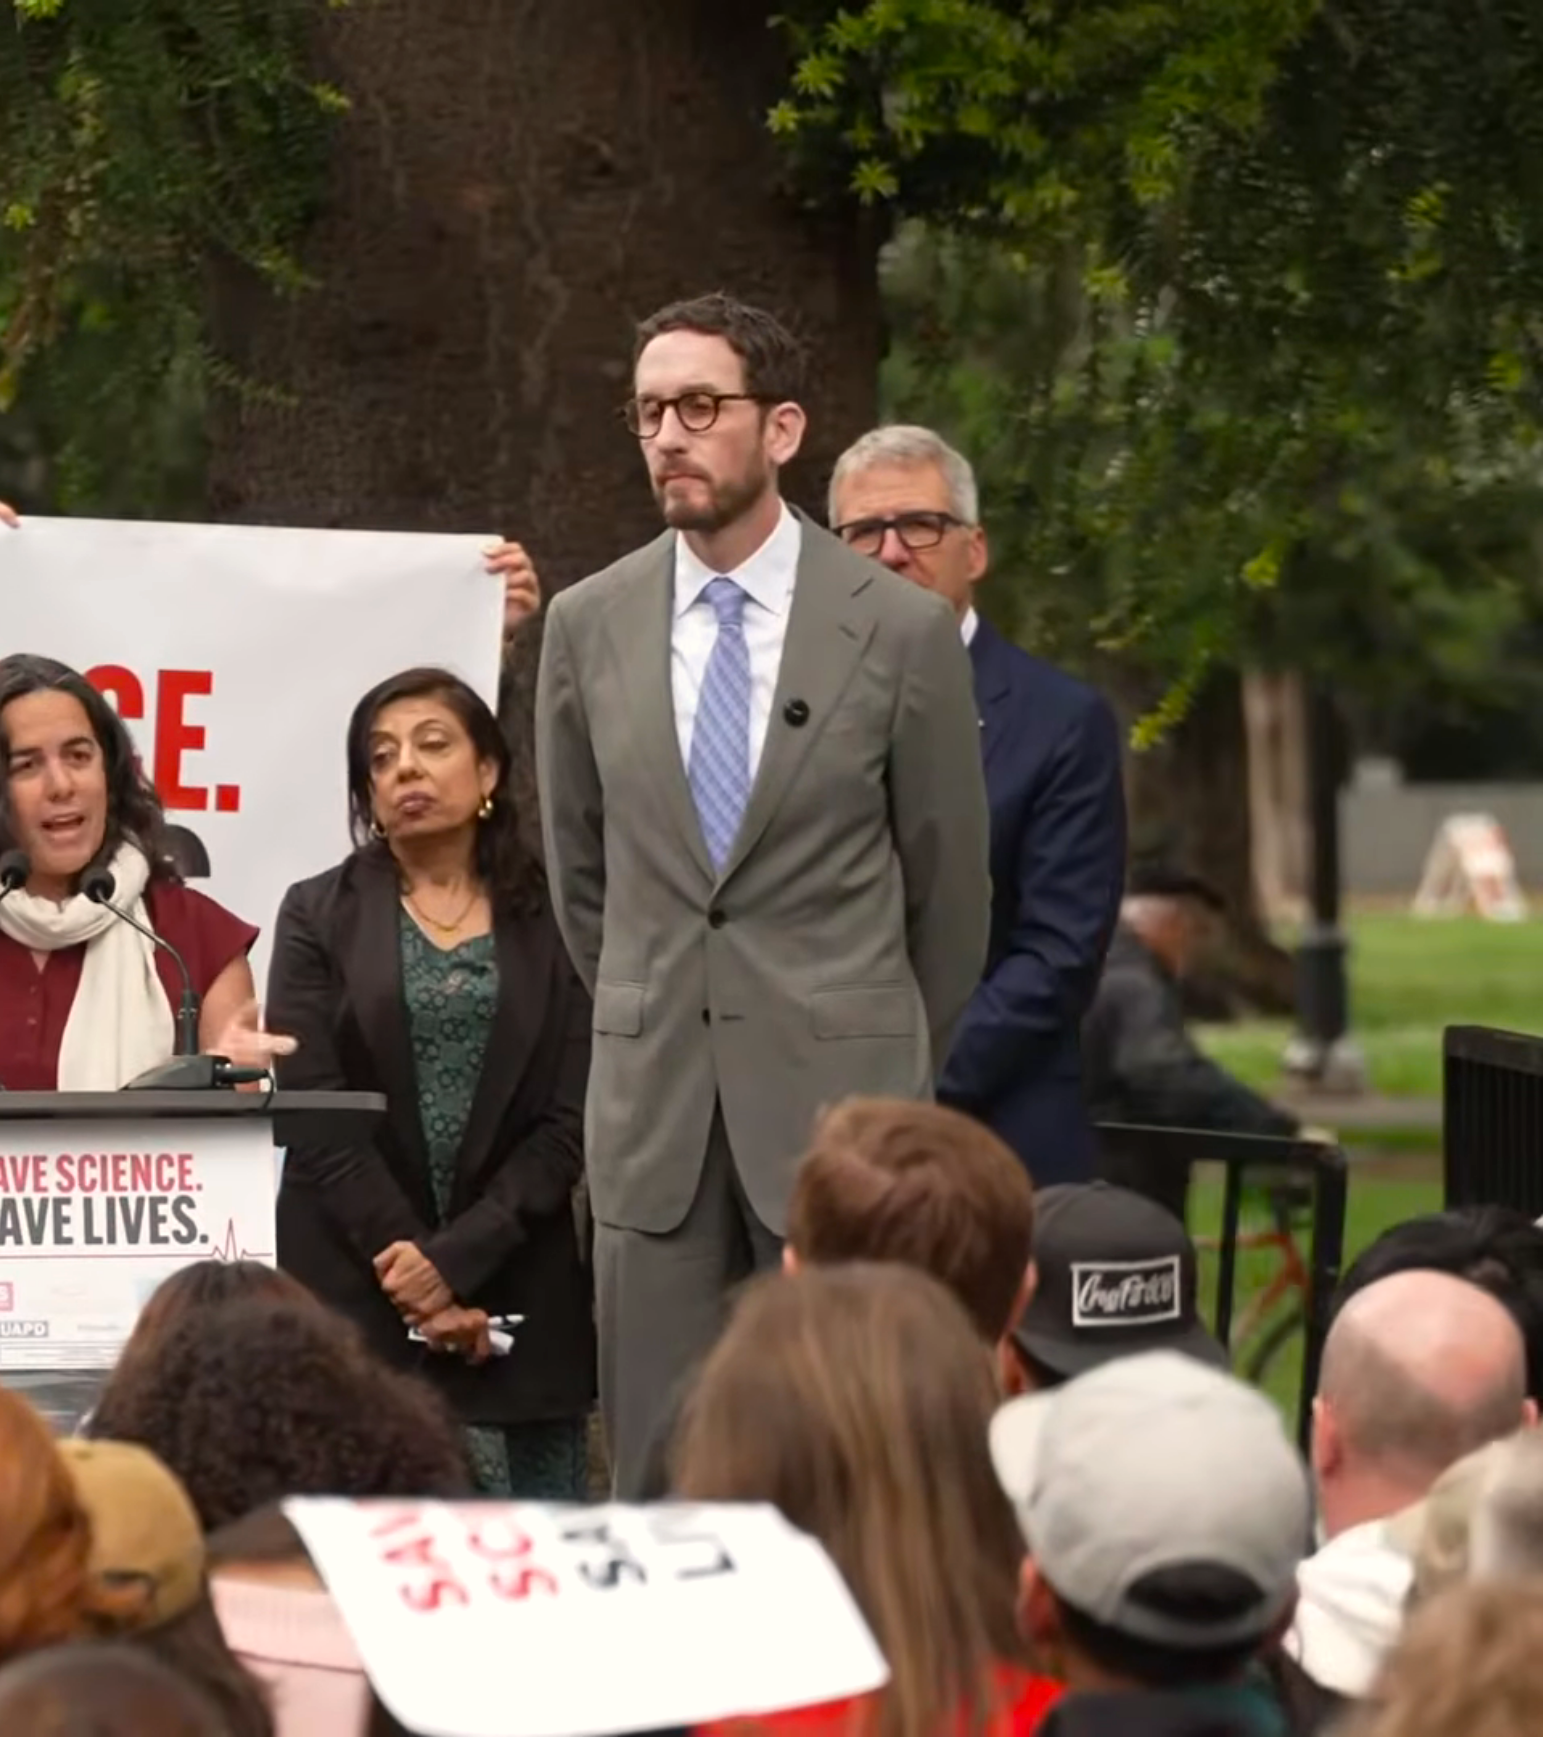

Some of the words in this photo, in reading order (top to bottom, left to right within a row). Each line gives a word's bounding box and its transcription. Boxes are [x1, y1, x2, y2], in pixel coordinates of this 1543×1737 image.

[55, 1153, 204, 1193] SCIENCE.
[83, 1195, 209, 1246] LIVES.
[0, 1322, 46, 1336] UAPD
